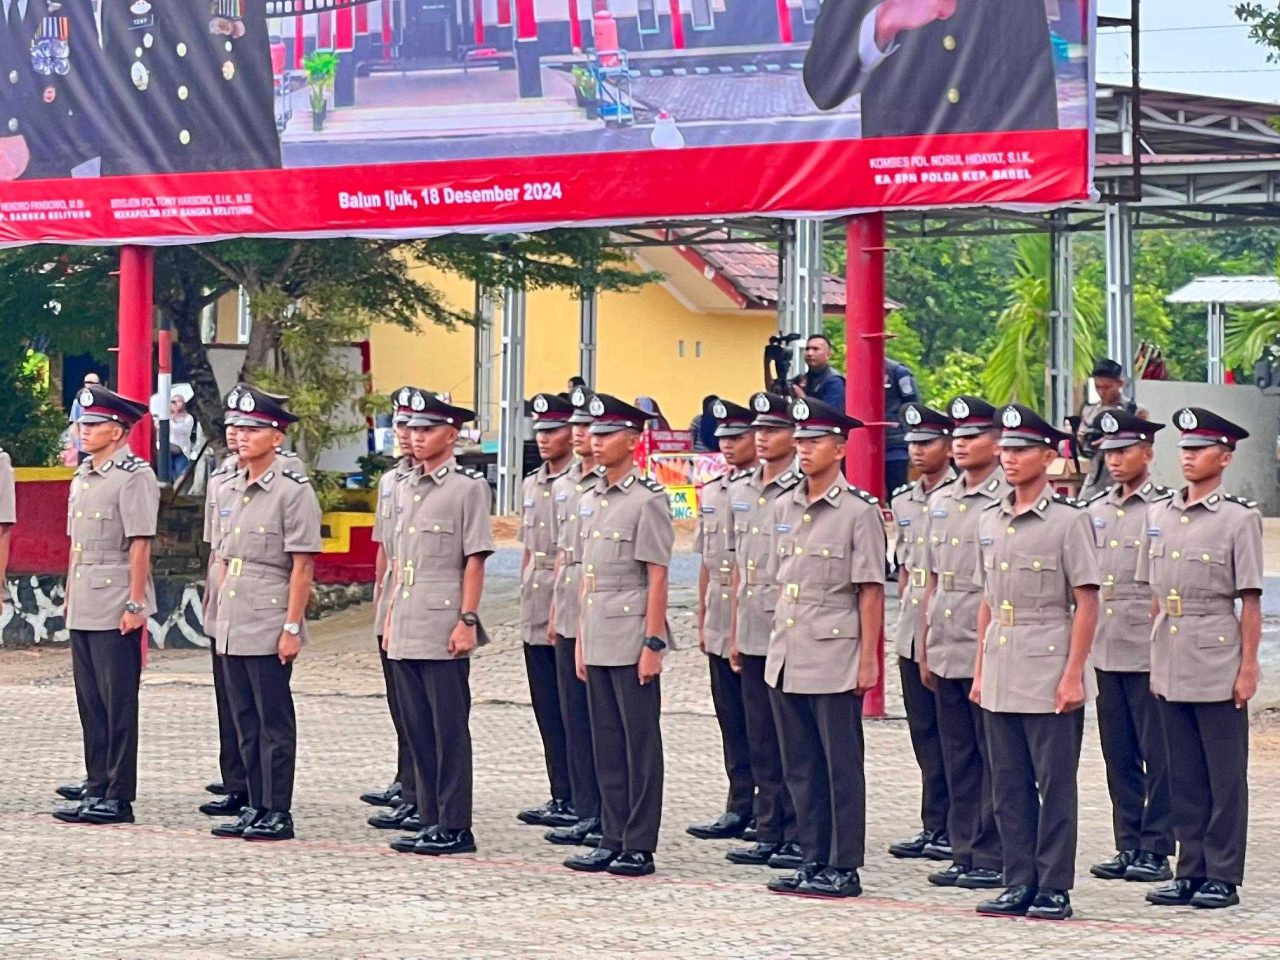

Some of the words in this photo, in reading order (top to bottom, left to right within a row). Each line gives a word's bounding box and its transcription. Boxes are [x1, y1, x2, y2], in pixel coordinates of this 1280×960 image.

[921, 171, 960, 183] POLDA
[338, 191, 382, 209] Balun
[421, 188, 440, 206] 18
[443, 185, 520, 205] Desember
[523, 182, 563, 201] 2024
